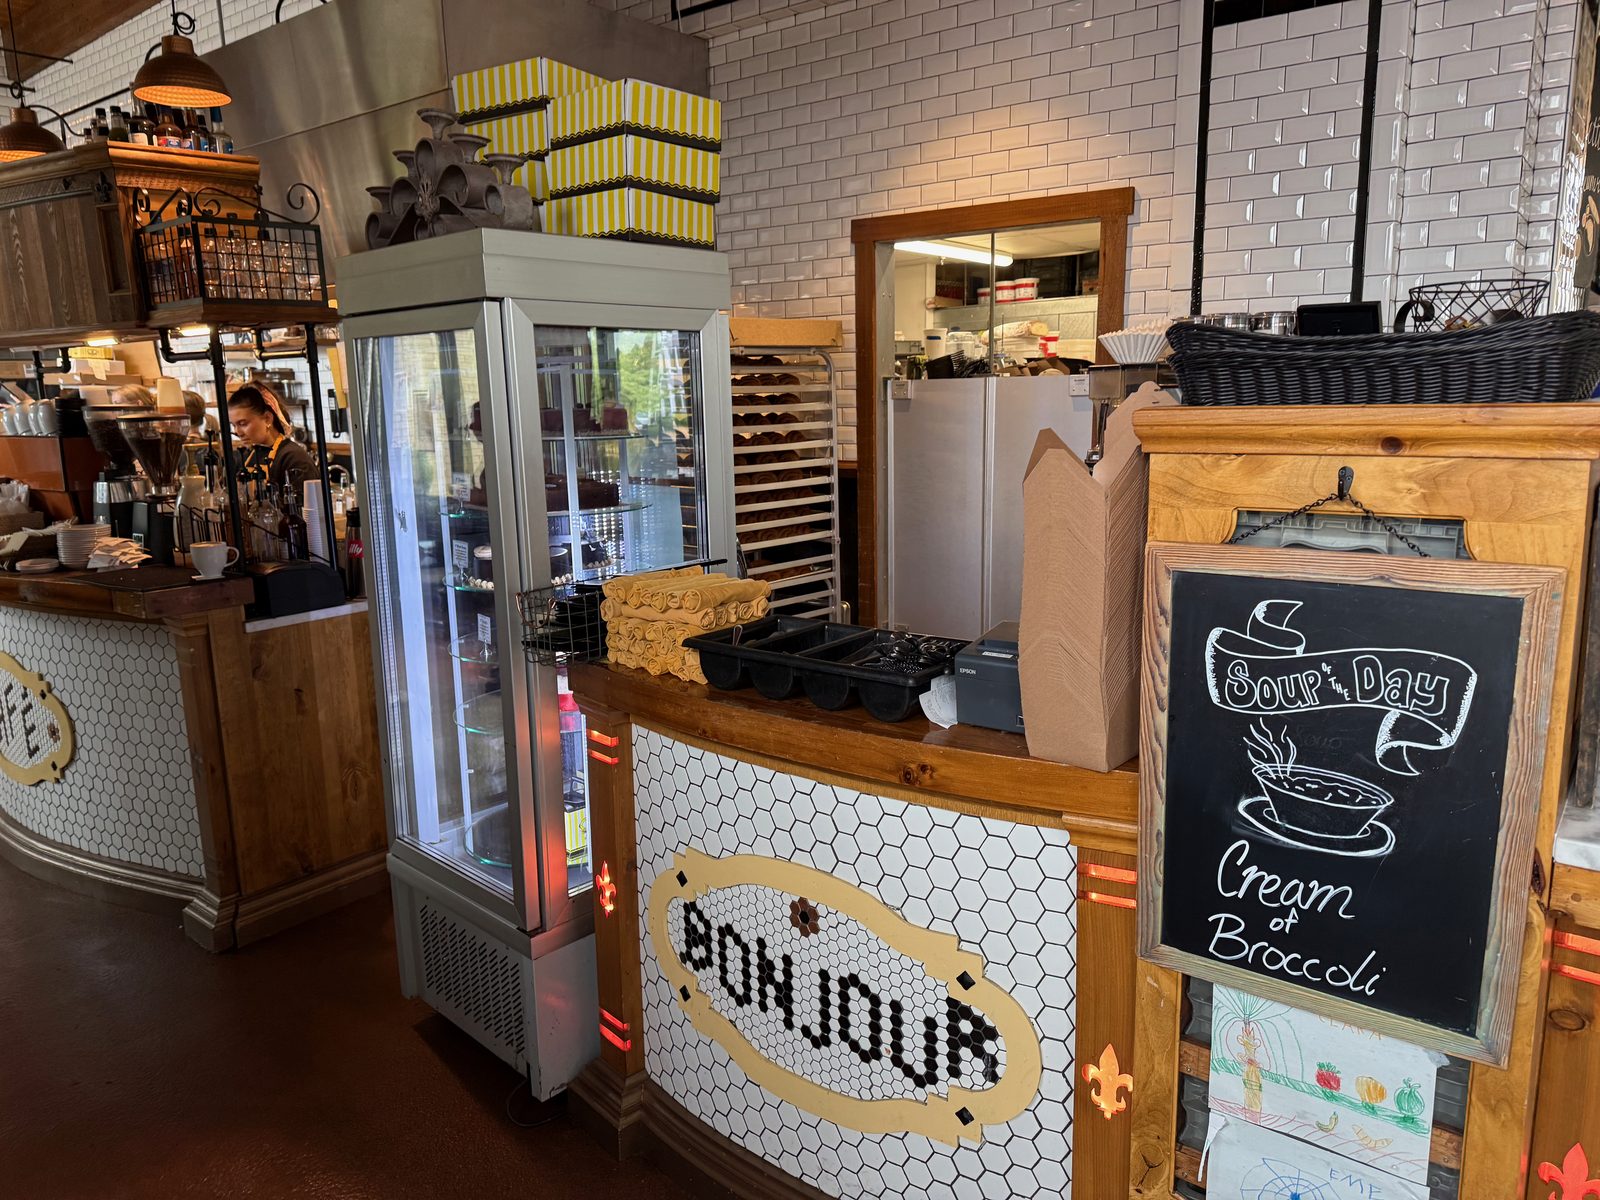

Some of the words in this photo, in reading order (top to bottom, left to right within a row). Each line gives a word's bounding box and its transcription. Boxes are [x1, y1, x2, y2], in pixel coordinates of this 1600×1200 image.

[348, 544, 363, 556] illy
[959, 667, 977, 675] EPSON
[1321, 661, 1332, 675] OF
[1327, 675, 1351, 701] THE
[1352, 655, 1450, 716] Day
[1216, 839, 1355, 919] Cream
[1269, 907, 1299, 933] of
[1208, 913, 1386, 996] Broccoli
[679, 901, 999, 1088] BONJOUR
